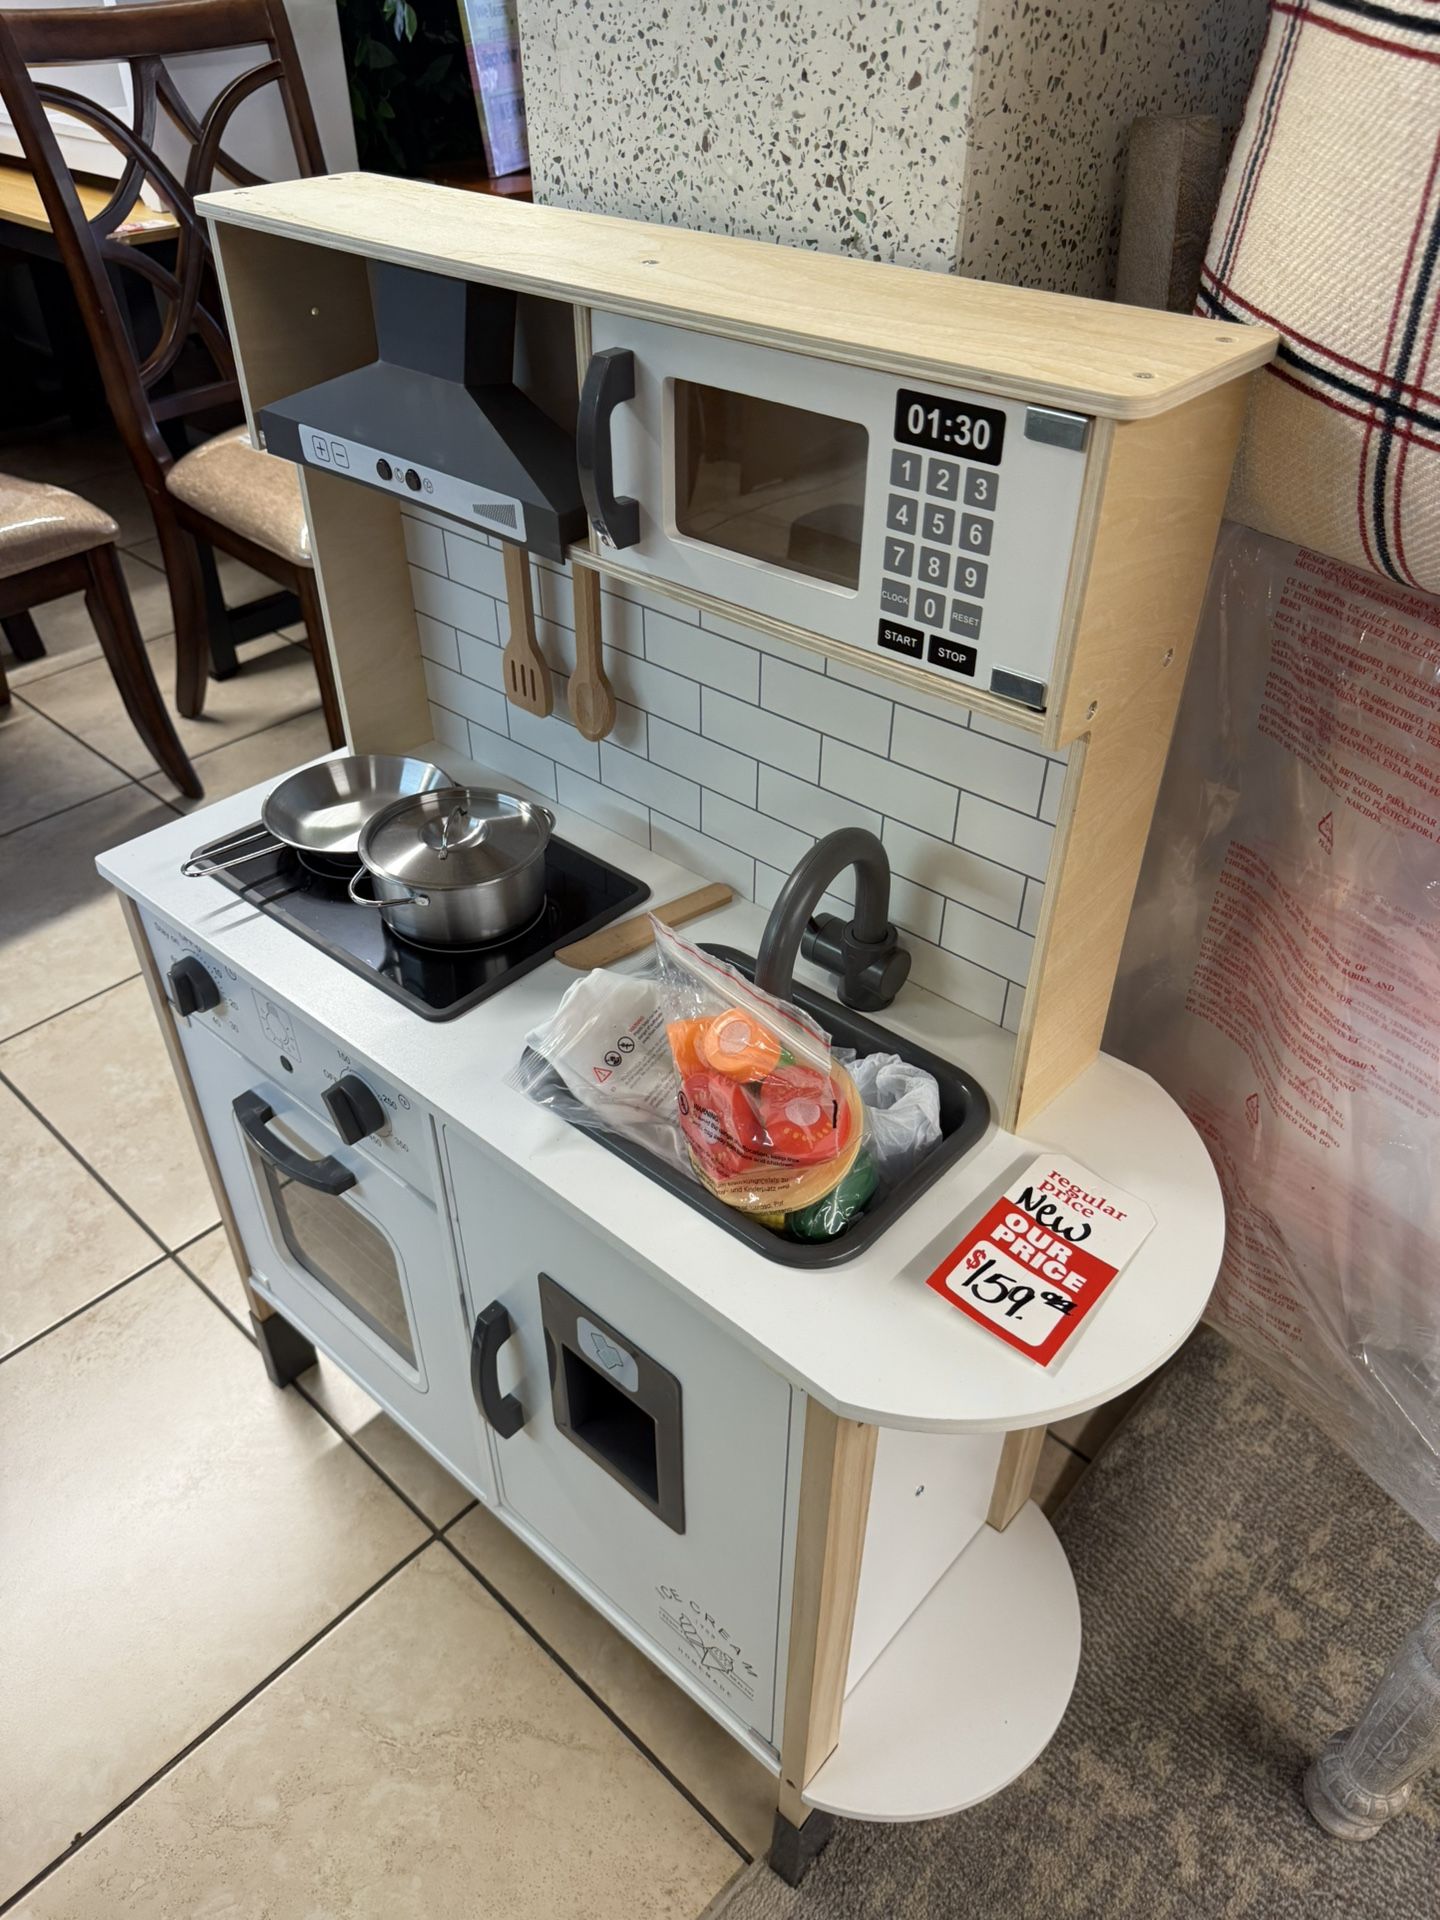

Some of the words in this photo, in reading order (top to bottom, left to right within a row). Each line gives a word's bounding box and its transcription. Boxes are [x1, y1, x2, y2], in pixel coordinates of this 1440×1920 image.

[907, 403, 991, 451] 01:30
[901, 459, 912, 482] 1
[935, 468, 950, 492] 2
[974, 478, 988, 501] 3
[895, 504, 909, 526] 4
[931, 513, 945, 535] 5
[969, 523, 983, 546] 6
[893, 546, 906, 567] 7
[927, 556, 941, 578] 8
[964, 567, 978, 588] 9
[881, 590, 910, 605] CLOCK
[924, 598, 937, 619] 0
[952, 611, 980, 627] RESET
[884, 629, 918, 648] START
[937, 647, 967, 664] STOP
[1355, 963, 1369, 973] OF
[1374, 981, 1395, 993] AND
[1015, 1186, 1093, 1242] New
[1036, 1179, 1095, 1219] price
[1047, 1170, 1128, 1222] regular
[989, 1223, 1088, 1294] PRICE
[1005, 1212, 1074, 1265] OUR
[655, 1585, 682, 1603] ICE
[689, 1599, 758, 1678] CREAM
